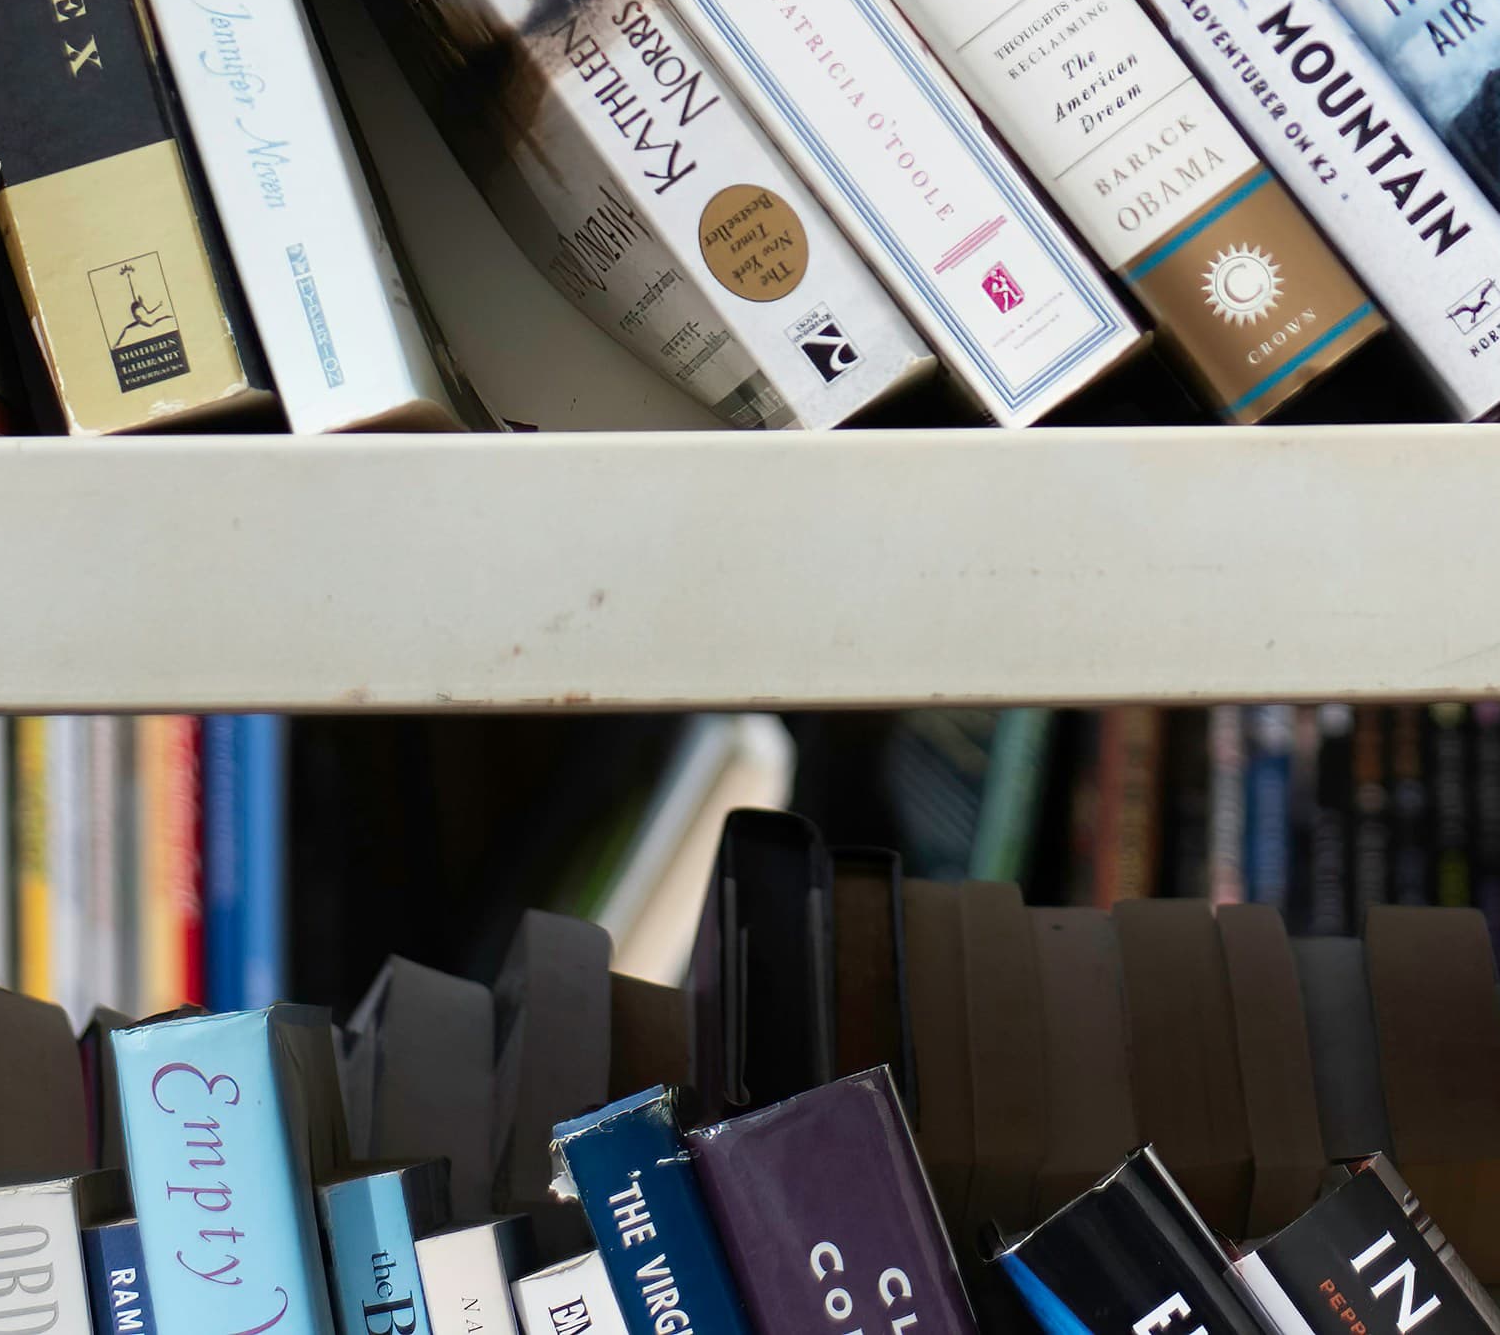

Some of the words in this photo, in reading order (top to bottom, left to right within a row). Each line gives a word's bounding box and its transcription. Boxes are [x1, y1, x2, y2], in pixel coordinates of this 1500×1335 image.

[549, 10, 698, 196] KATHLEEN
[611, 0, 721, 128] NORRIS
[1256, 1, 1473, 258] MOUNTAIN
[1092, 114, 1198, 198] BARACK
[1115, 145, 1228, 234] OBAMA
[150, 1062, 246, 1287] Empty
